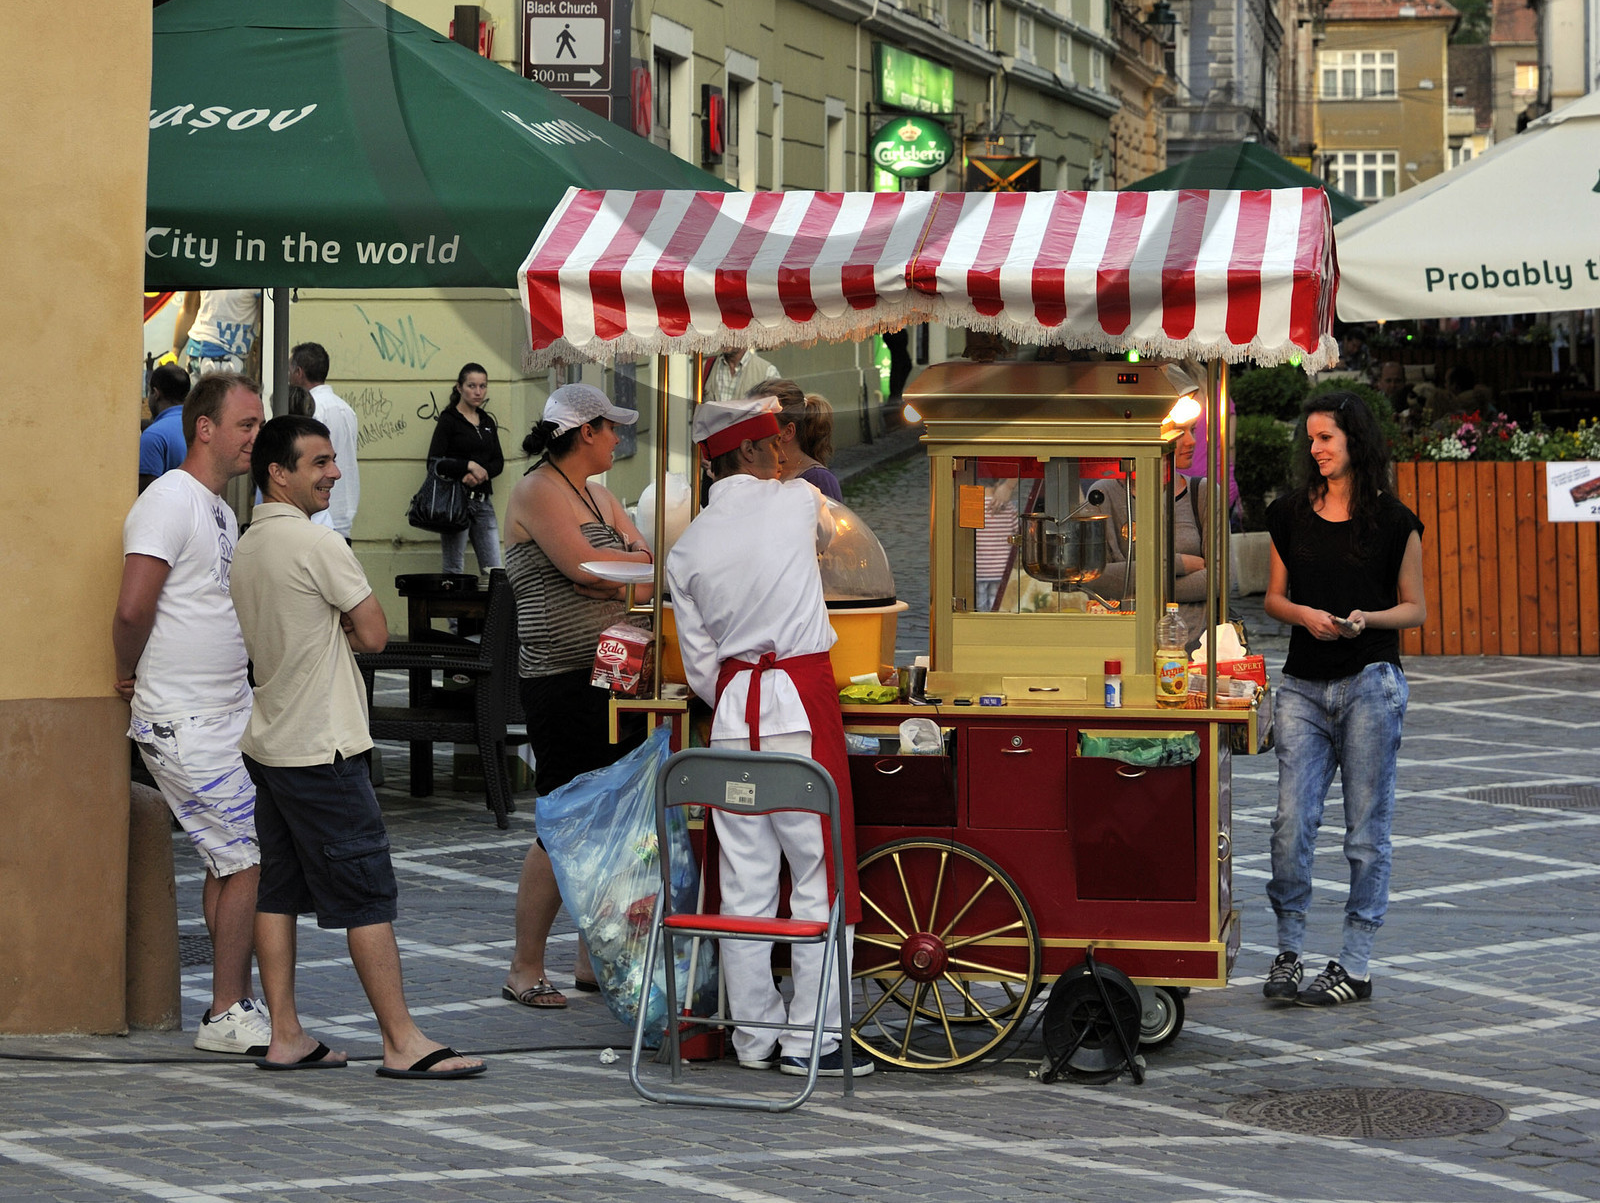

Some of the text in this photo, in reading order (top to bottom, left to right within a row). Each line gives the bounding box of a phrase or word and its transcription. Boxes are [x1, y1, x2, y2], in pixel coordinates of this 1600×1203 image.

[526, 0, 598, 15] Black Church
[531, 69, 570, 82] 300 m
[149, 102, 318, 135] așov
[873, 141, 946, 166] Carlsberg
[145, 226, 460, 268] City in the world
[1425, 258, 1600, 293] Probably t
[598, 641, 625, 655] gala
[1158, 664, 1185, 679] Argus
[1232, 661, 1262, 672] EXPERT
